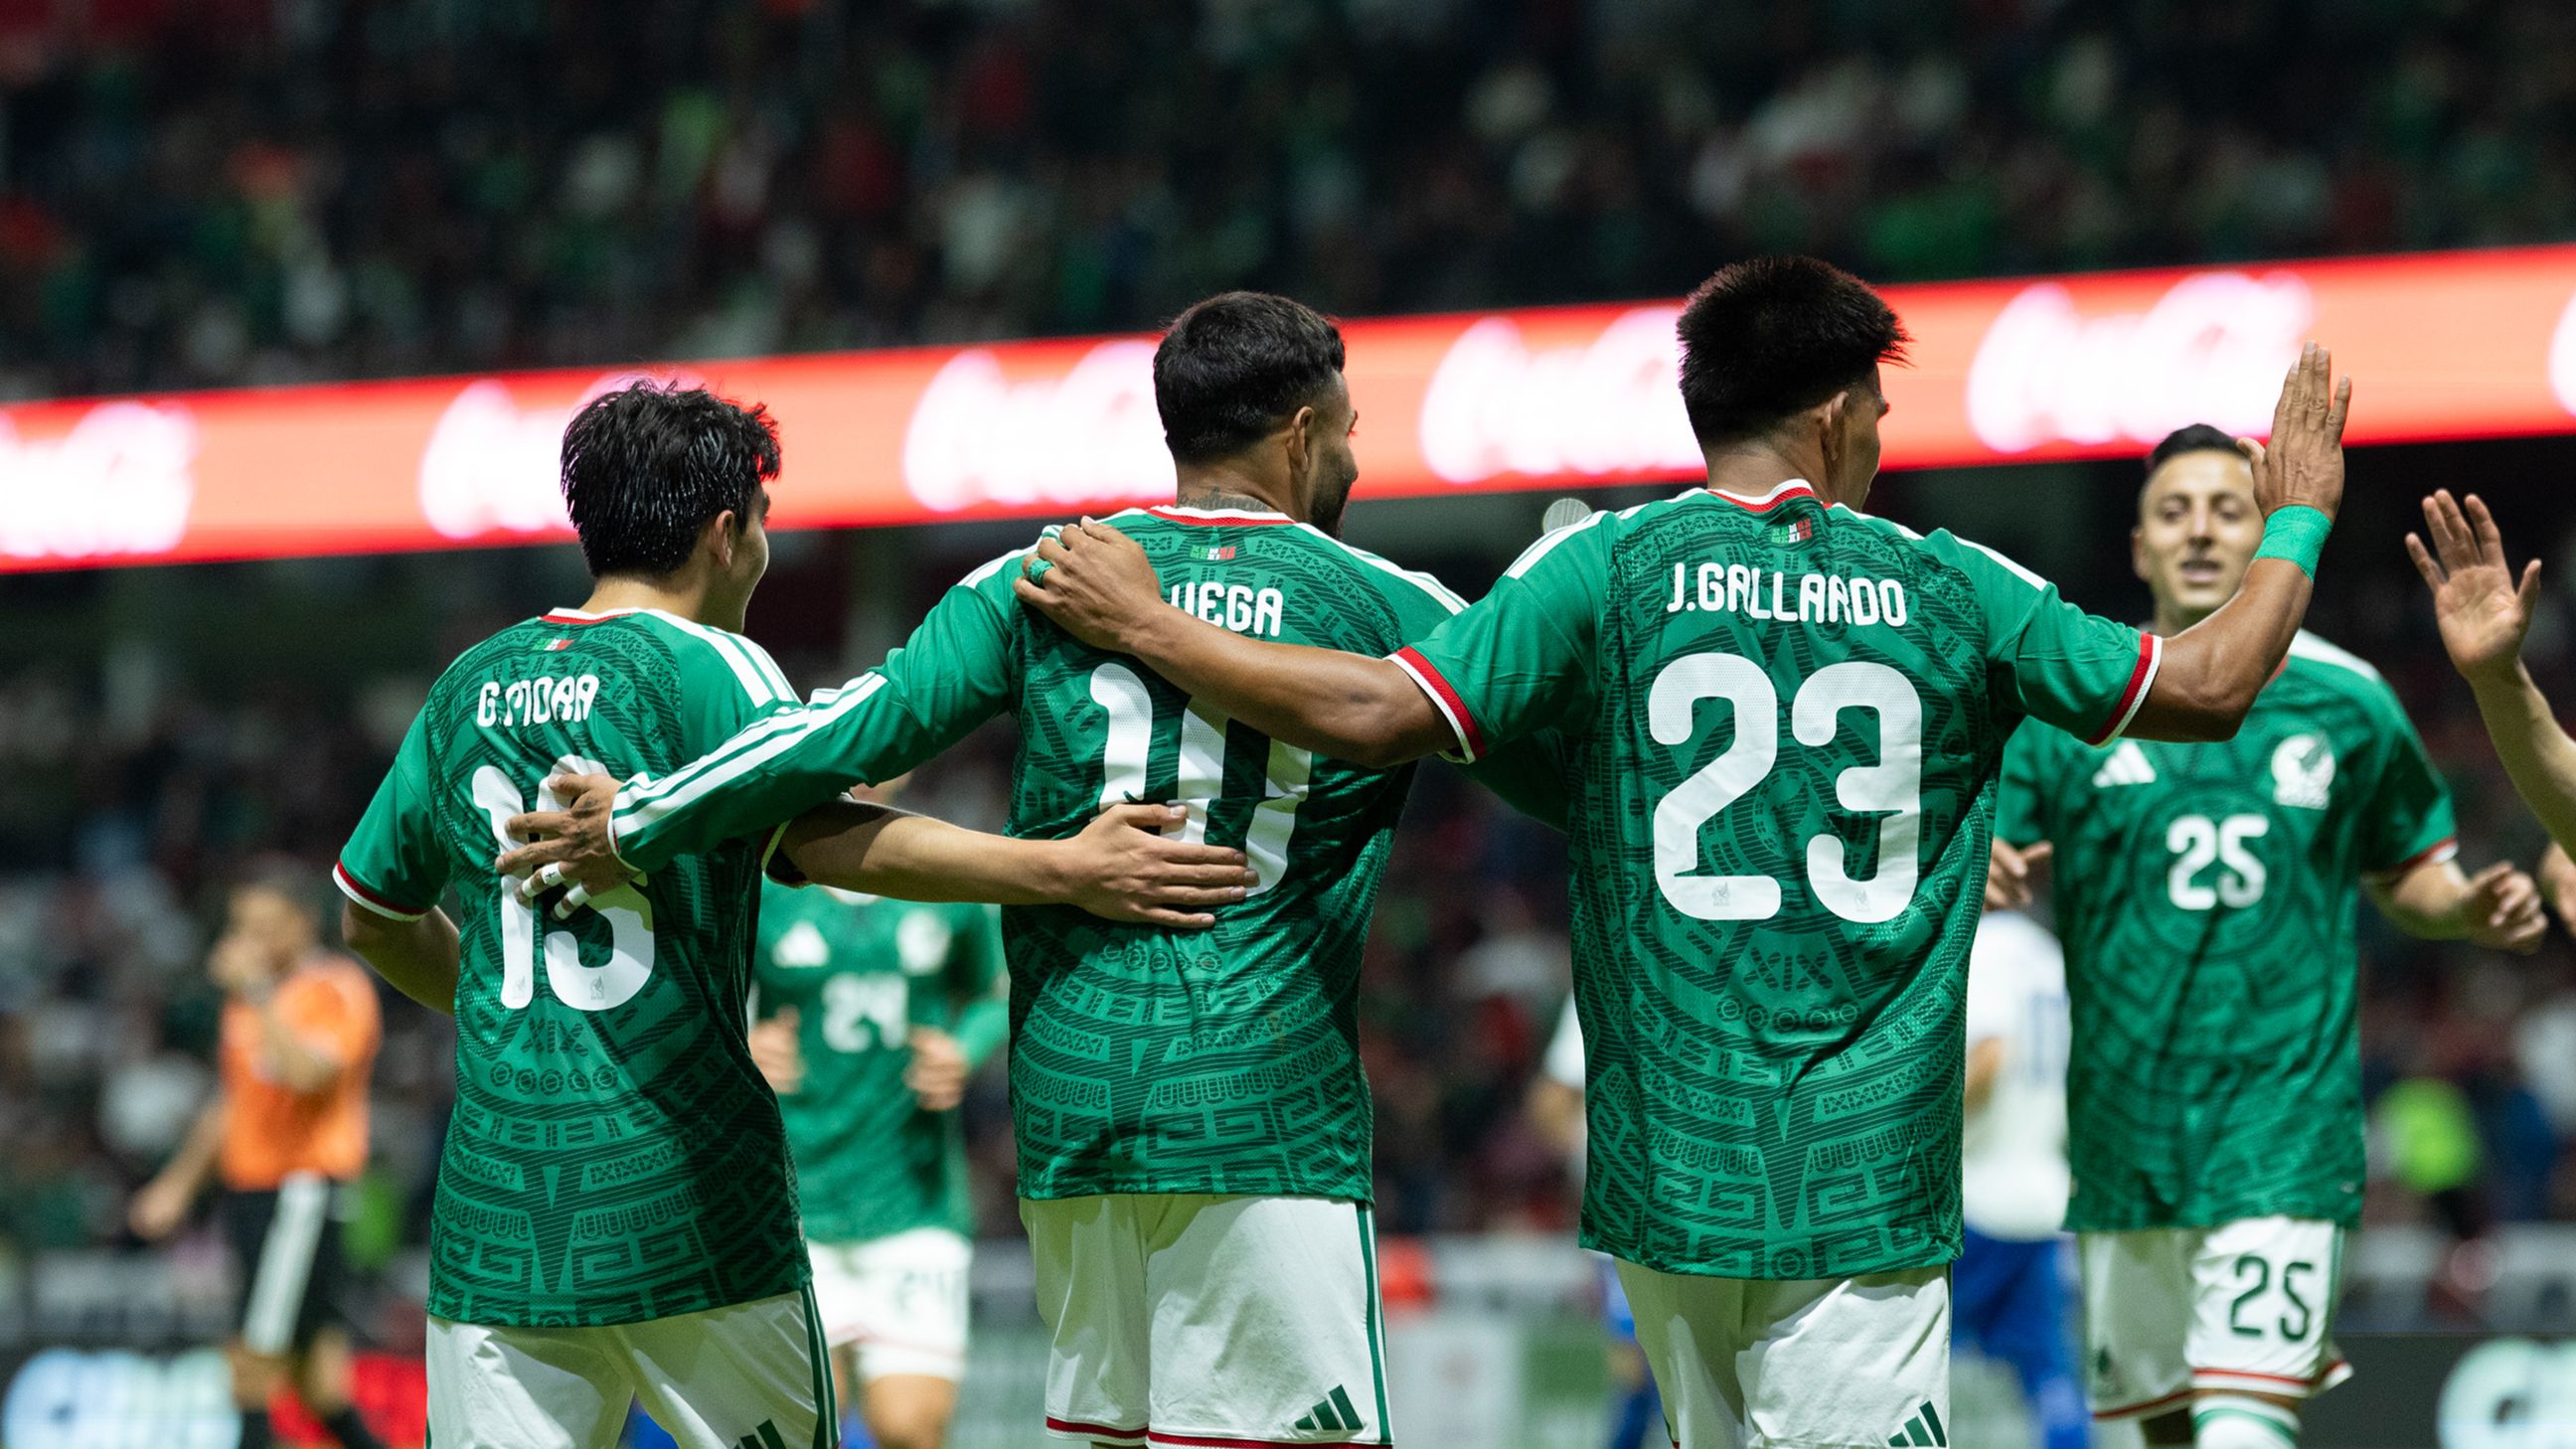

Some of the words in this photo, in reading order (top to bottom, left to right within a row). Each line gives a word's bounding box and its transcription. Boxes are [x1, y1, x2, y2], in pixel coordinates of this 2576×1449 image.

[1667, 563, 1907, 627] J.GALLARDO
[1648, 652, 1922, 923] 23
[2166, 814, 2269, 910] 25
[821, 970, 909, 1053] 24
[2230, 1255, 2314, 1342] 25
